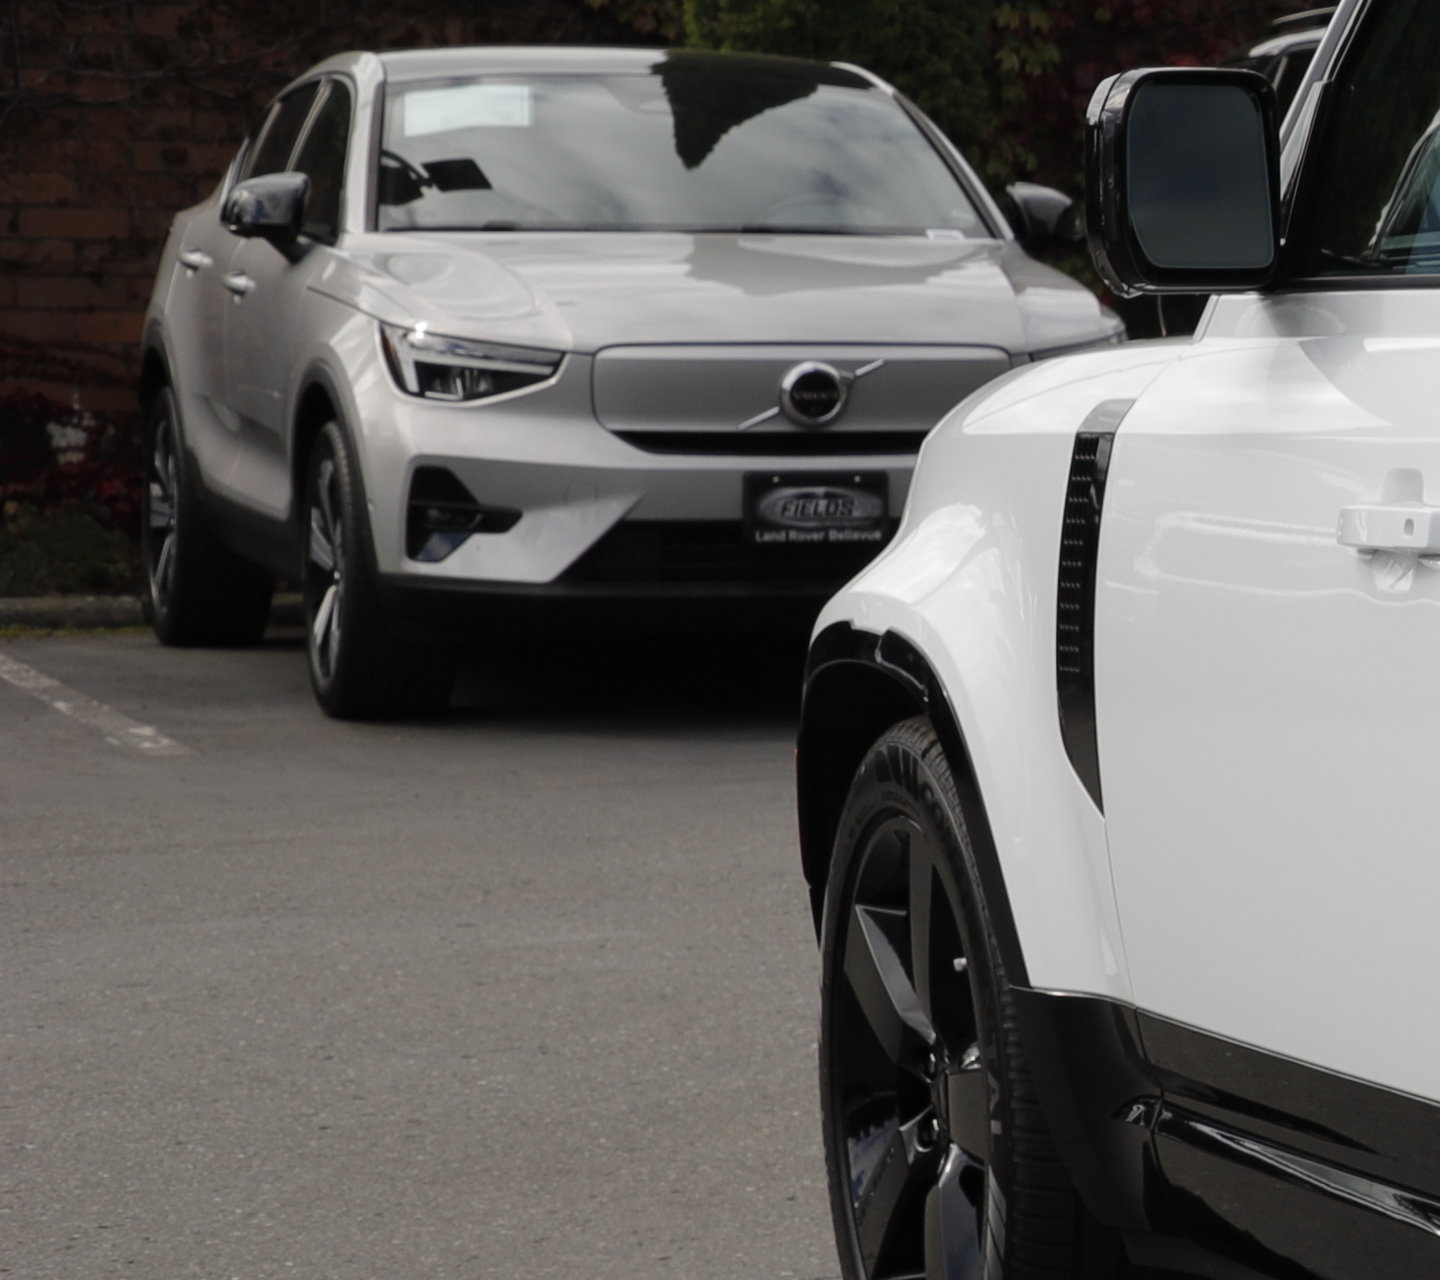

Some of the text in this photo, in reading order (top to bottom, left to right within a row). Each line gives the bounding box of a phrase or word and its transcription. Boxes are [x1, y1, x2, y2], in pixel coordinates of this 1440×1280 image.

[780, 498, 855, 517] FIELDS
[755, 528, 882, 543] Land Rover Bellevue
